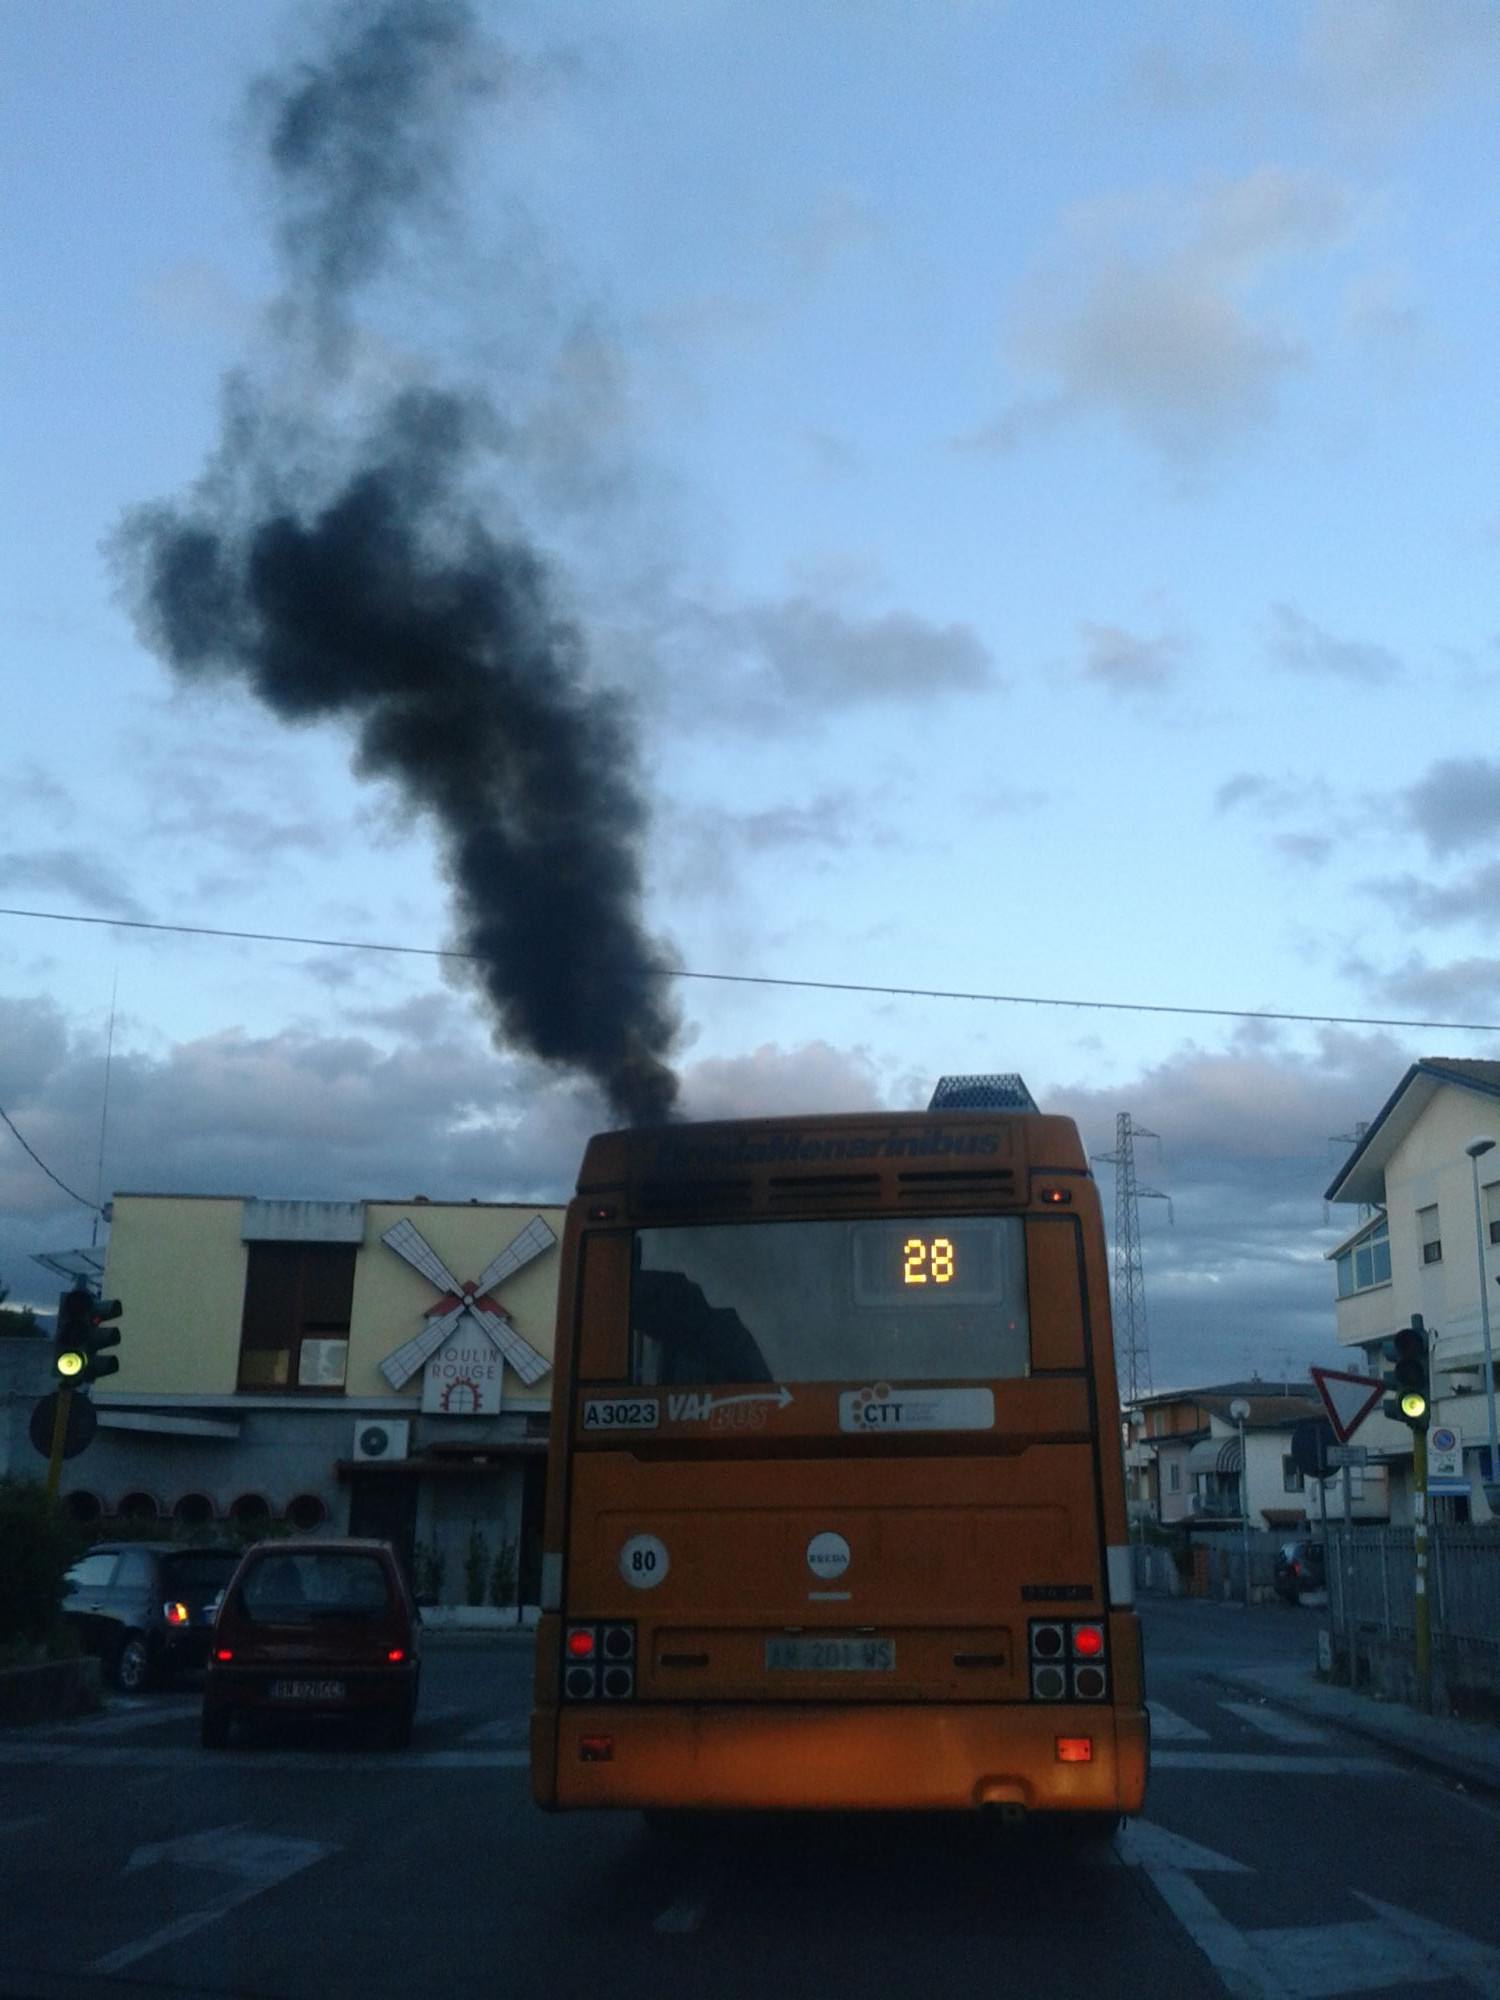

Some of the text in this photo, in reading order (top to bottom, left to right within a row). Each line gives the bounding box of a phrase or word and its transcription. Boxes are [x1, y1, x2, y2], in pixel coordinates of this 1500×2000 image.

[904, 1239, 953, 1283] 28
[432, 1348, 497, 1361] MOULIN
[432, 1364, 495, 1379] ROUGE
[586, 1404, 655, 1425] A3023
[864, 1404, 903, 1422] CTT
[632, 1550, 656, 1571] 80
[809, 1554, 847, 1563] BREDA
